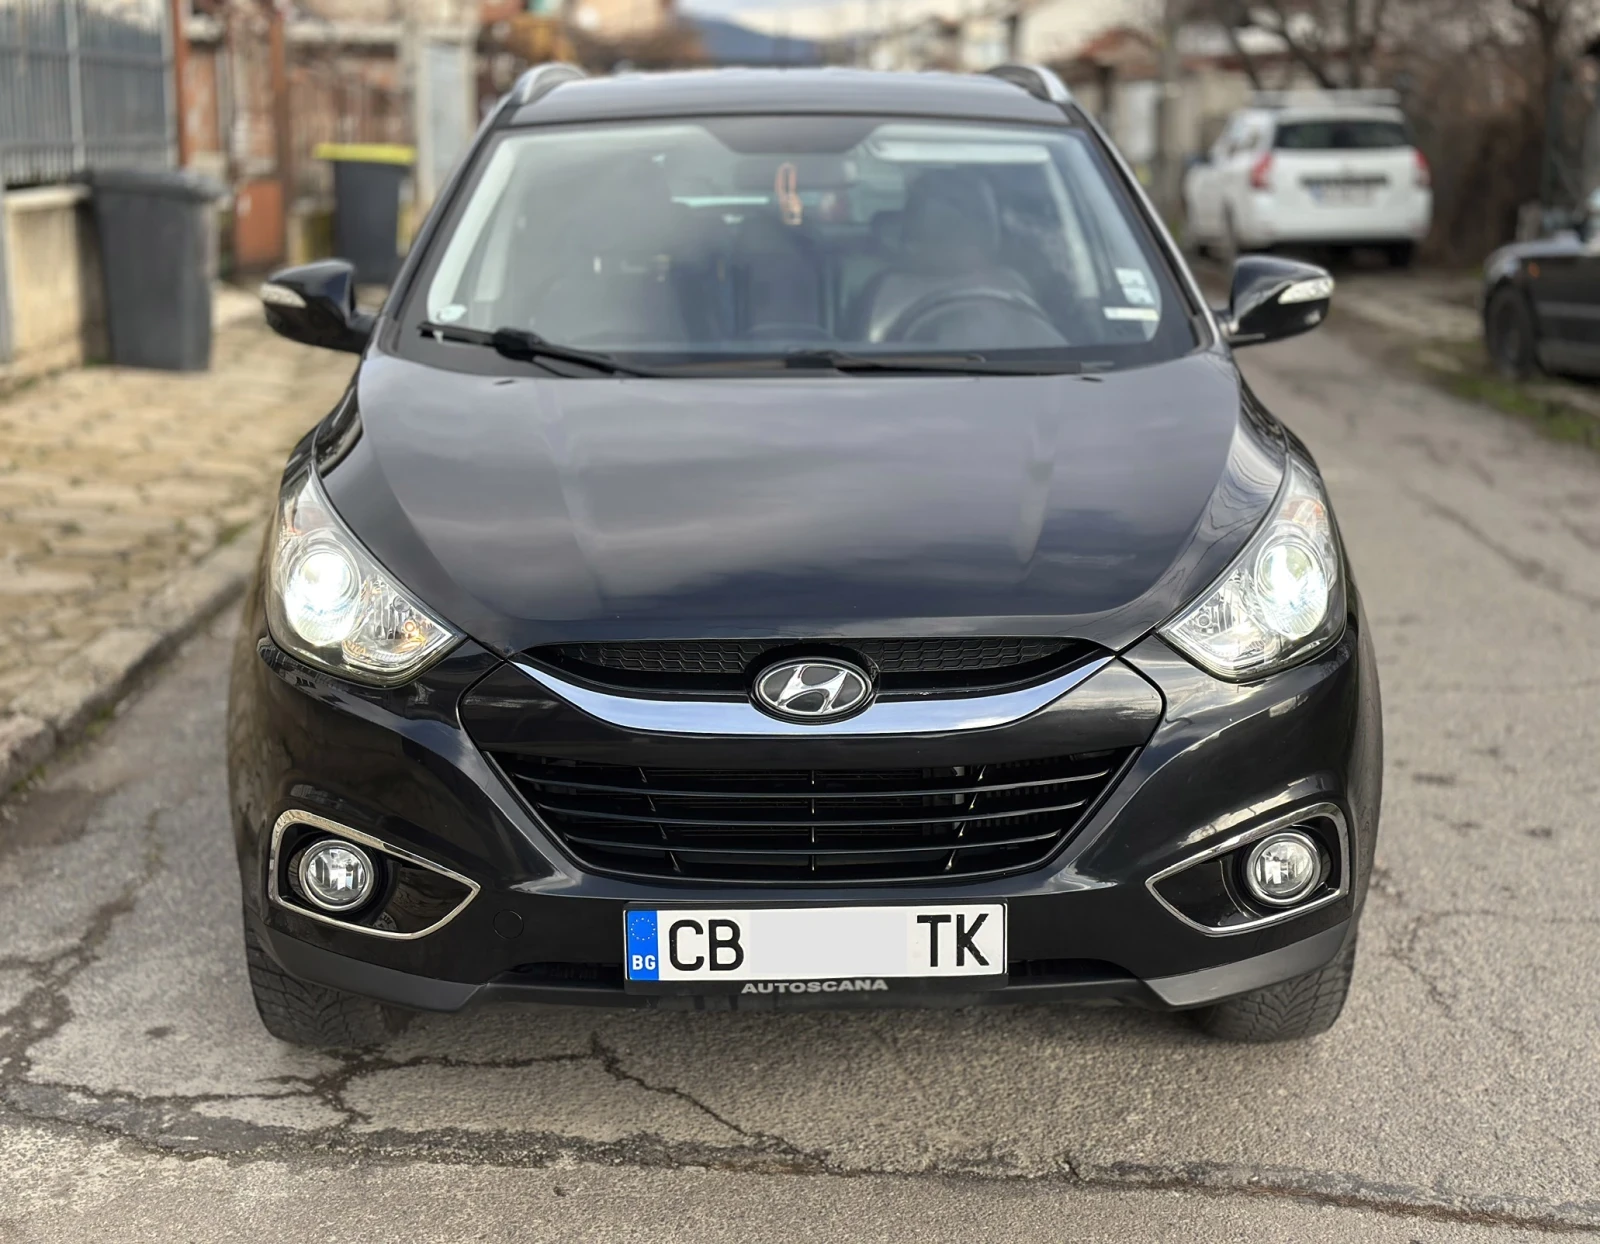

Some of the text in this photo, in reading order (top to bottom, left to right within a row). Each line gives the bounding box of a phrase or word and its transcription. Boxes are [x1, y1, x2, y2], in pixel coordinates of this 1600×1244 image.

[668, 912, 990, 971] CB TK
[631, 953, 656, 971] BG
[740, 978, 889, 994] AUTOSCANA
